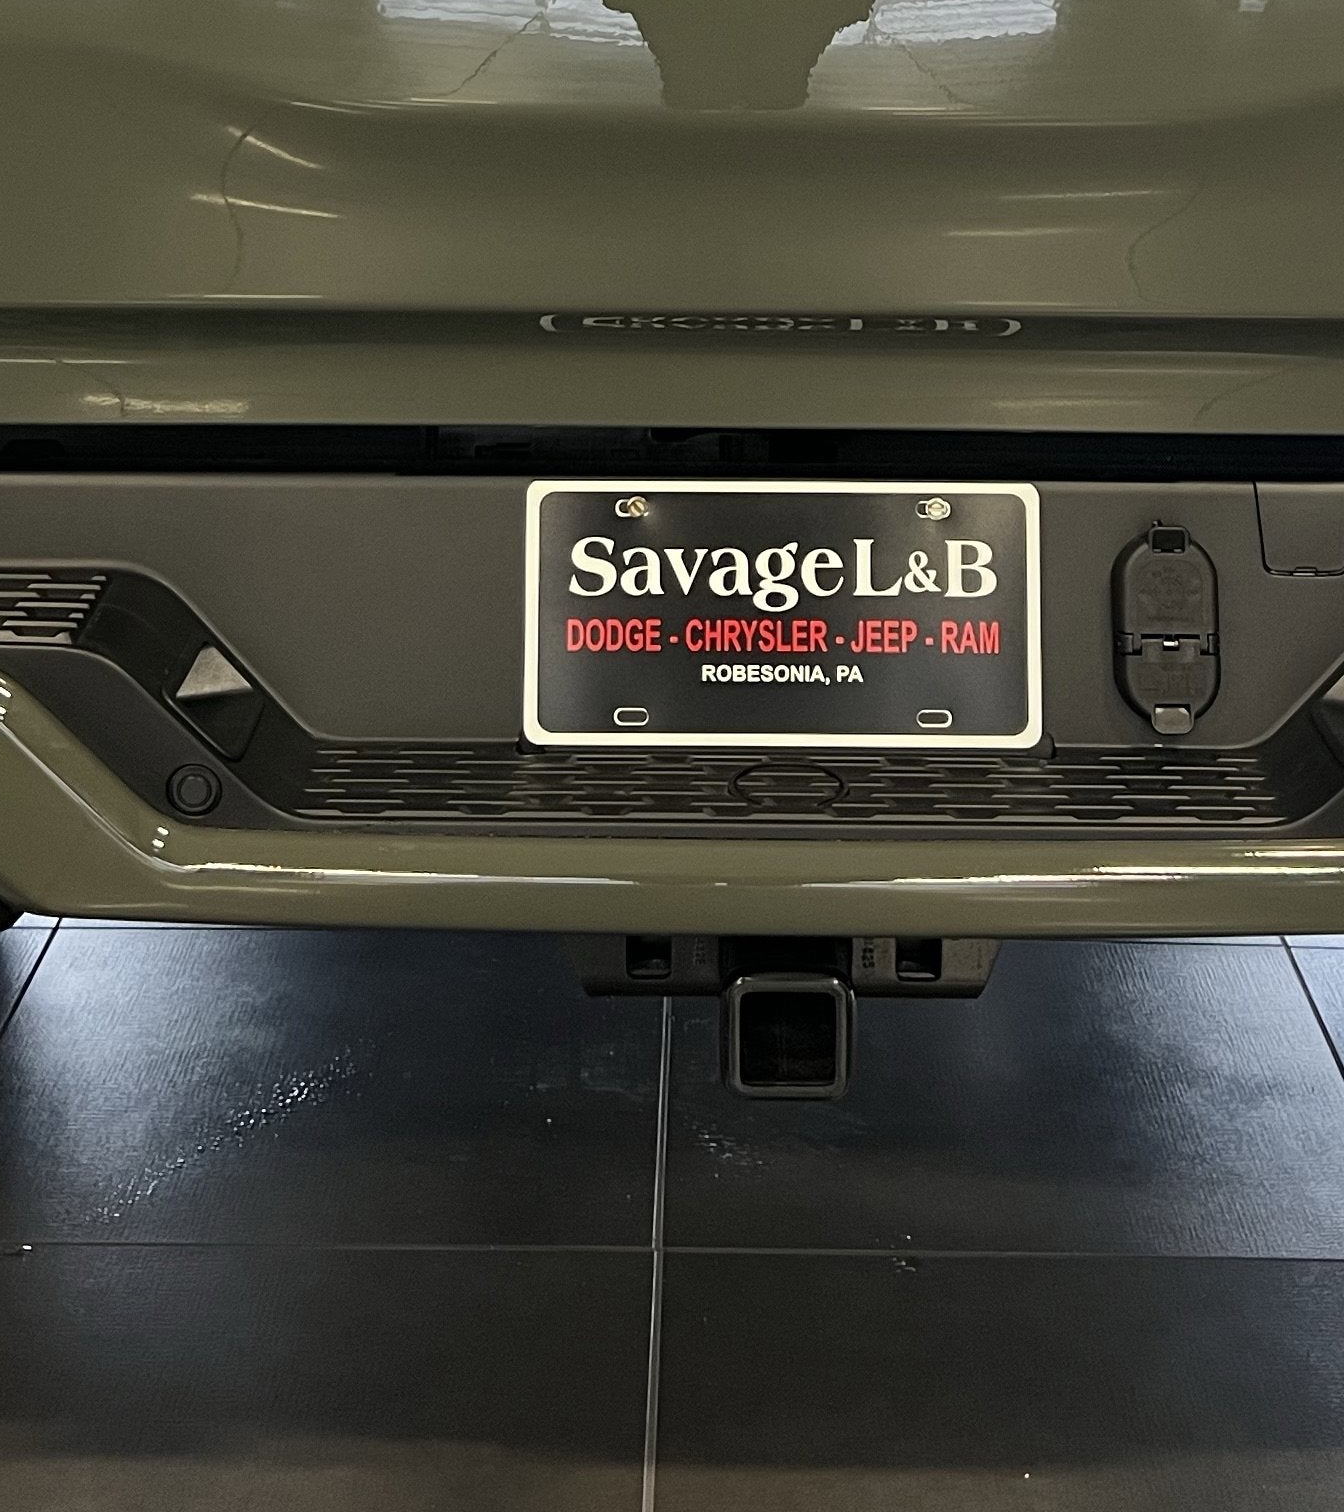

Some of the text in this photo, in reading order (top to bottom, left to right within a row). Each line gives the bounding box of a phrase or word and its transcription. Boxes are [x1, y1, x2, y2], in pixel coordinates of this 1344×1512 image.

[568, 536, 844, 613] Savage
[566, 618, 662, 653] DODGE
[684, 619, 828, 653] CHRYSLER
[850, 619, 918, 654] JEEP
[940, 621, 1001, 655] RAM
[701, 664, 864, 686] ROBESONIA, PA
